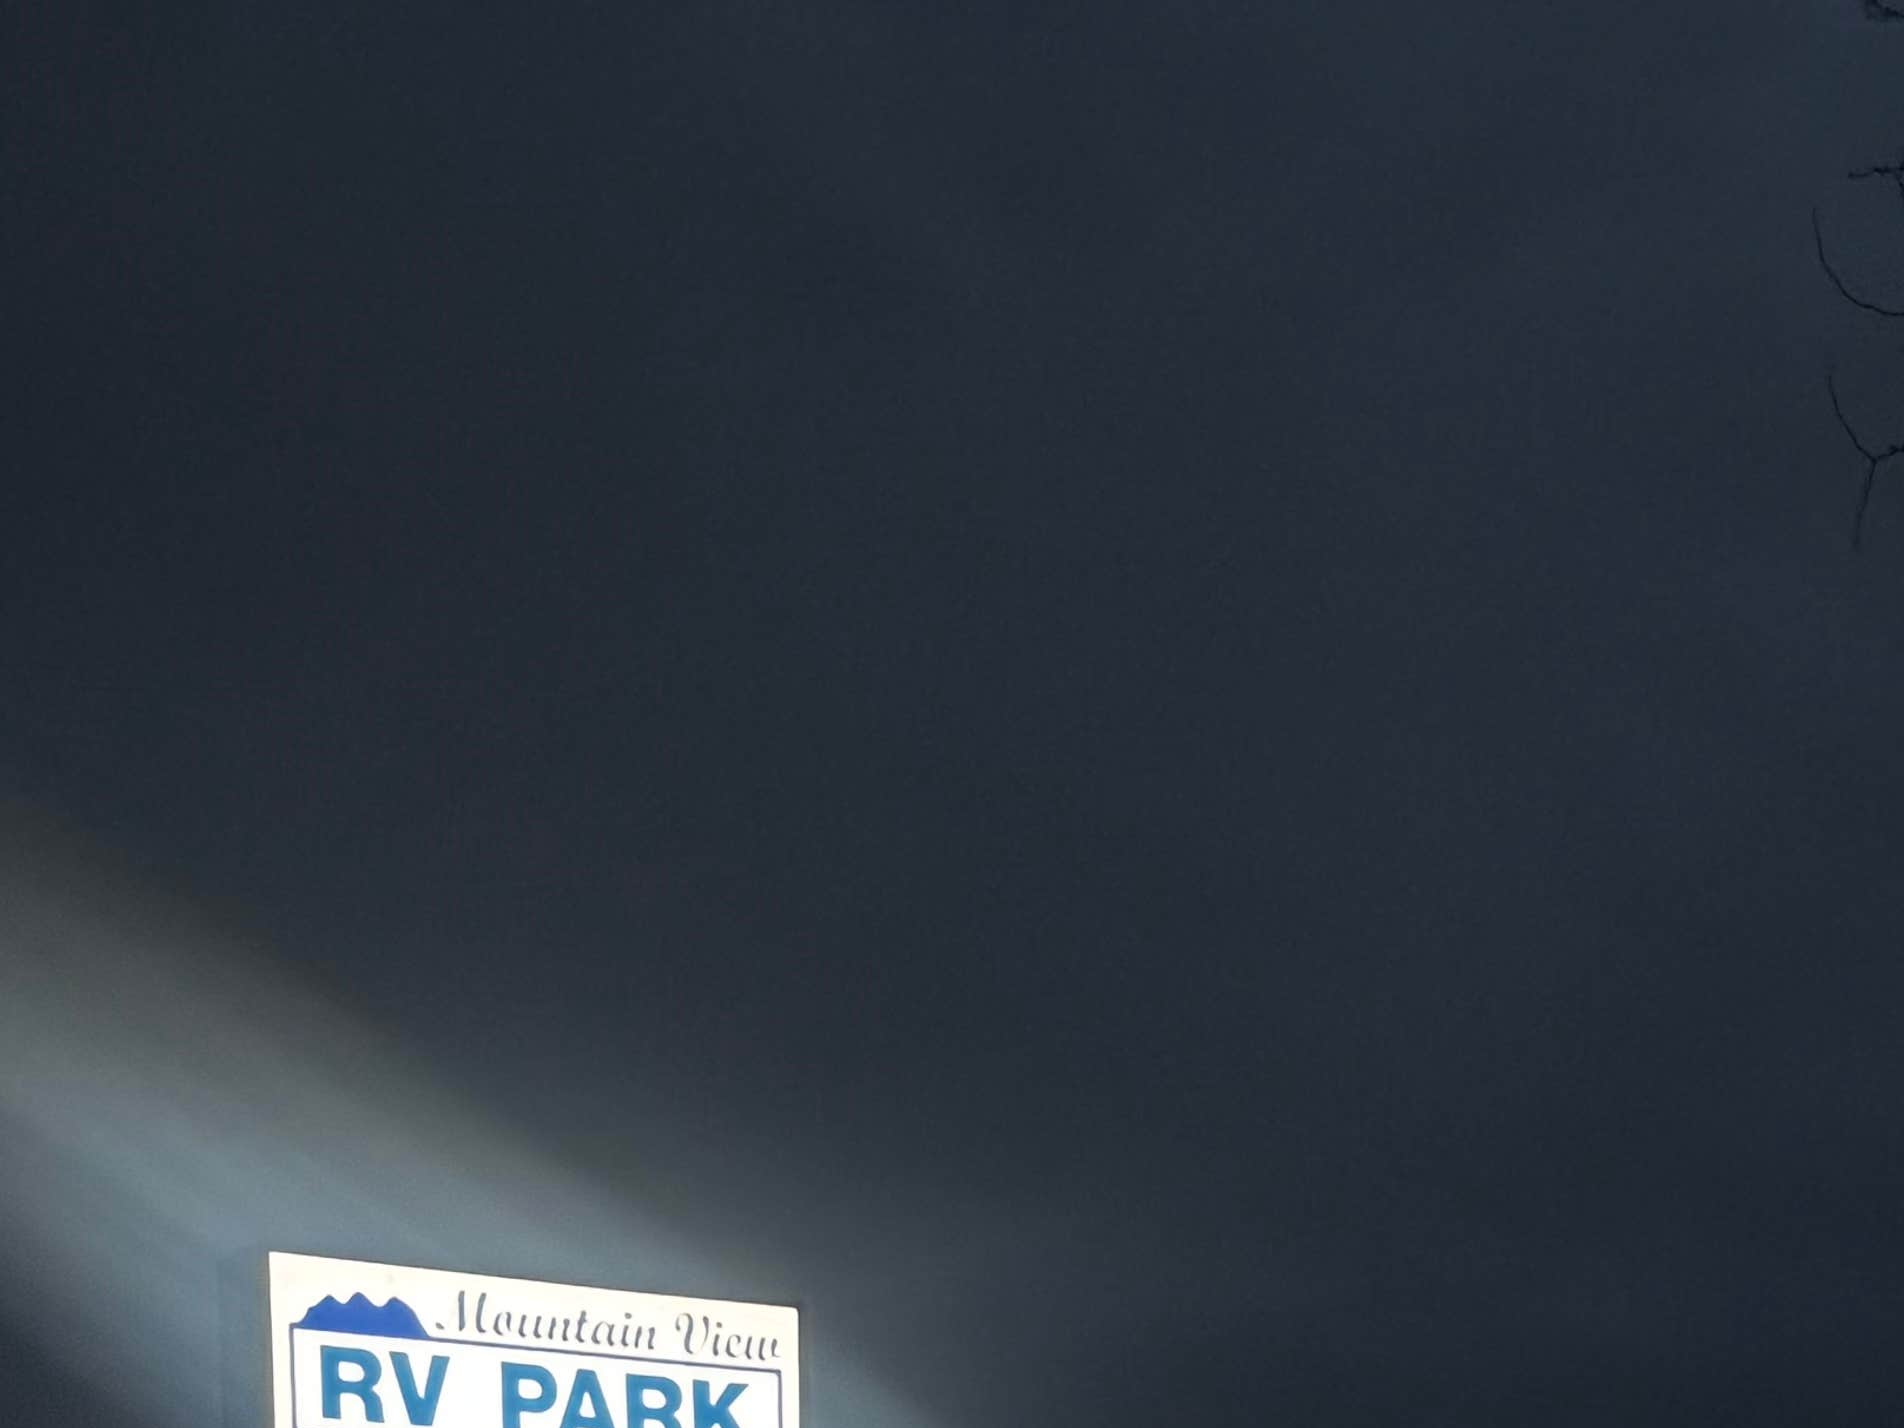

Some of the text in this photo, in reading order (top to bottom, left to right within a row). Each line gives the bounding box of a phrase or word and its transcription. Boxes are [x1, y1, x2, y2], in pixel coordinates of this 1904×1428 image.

[435, 1290, 782, 1361] Mountain View
[319, 1344, 450, 1427] RV
